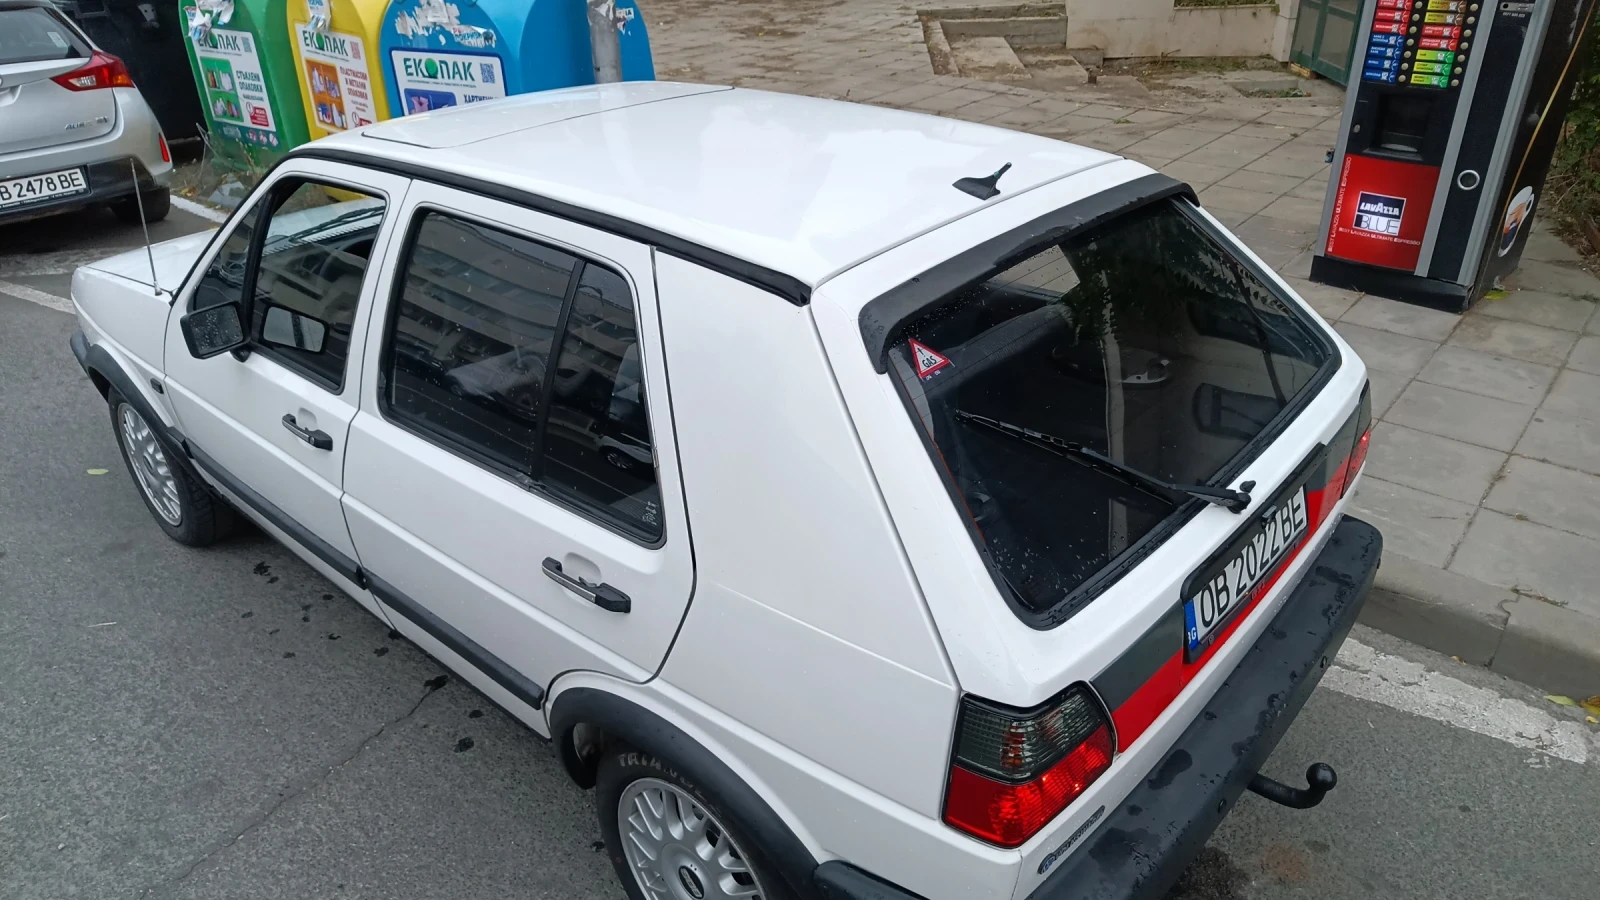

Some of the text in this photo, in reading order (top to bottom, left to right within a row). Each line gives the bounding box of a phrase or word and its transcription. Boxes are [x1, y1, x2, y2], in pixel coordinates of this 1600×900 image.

[302, 30, 349, 57] ЕКОПАК
[403, 57, 476, 82] ЕКОПАК
[463, 94, 494, 104] ХАРТИЕ
[1341, 157, 1352, 187] ESPRESSO
[0, 184, 12, 201] B
[13, 177, 57, 199] 2478
[58, 171, 82, 189] BE
[1335, 187, 1346, 214] ULTIMATE
[1360, 202, 1400, 216] LAVAZZA
[1331, 214, 1340, 238] LAVAZZA
[1361, 215, 1400, 234] BLUE
[1350, 229, 1370, 238] LAVAZZA
[1370, 233, 1394, 242] ULTIMATE
[1394, 237, 1421, 246] ESPRESSO
[922, 355, 937, 368] GAS
[1200, 574, 1230, 628] OB
[1232, 522, 1280, 598] 2022
[1282, 498, 1305, 545] BE
